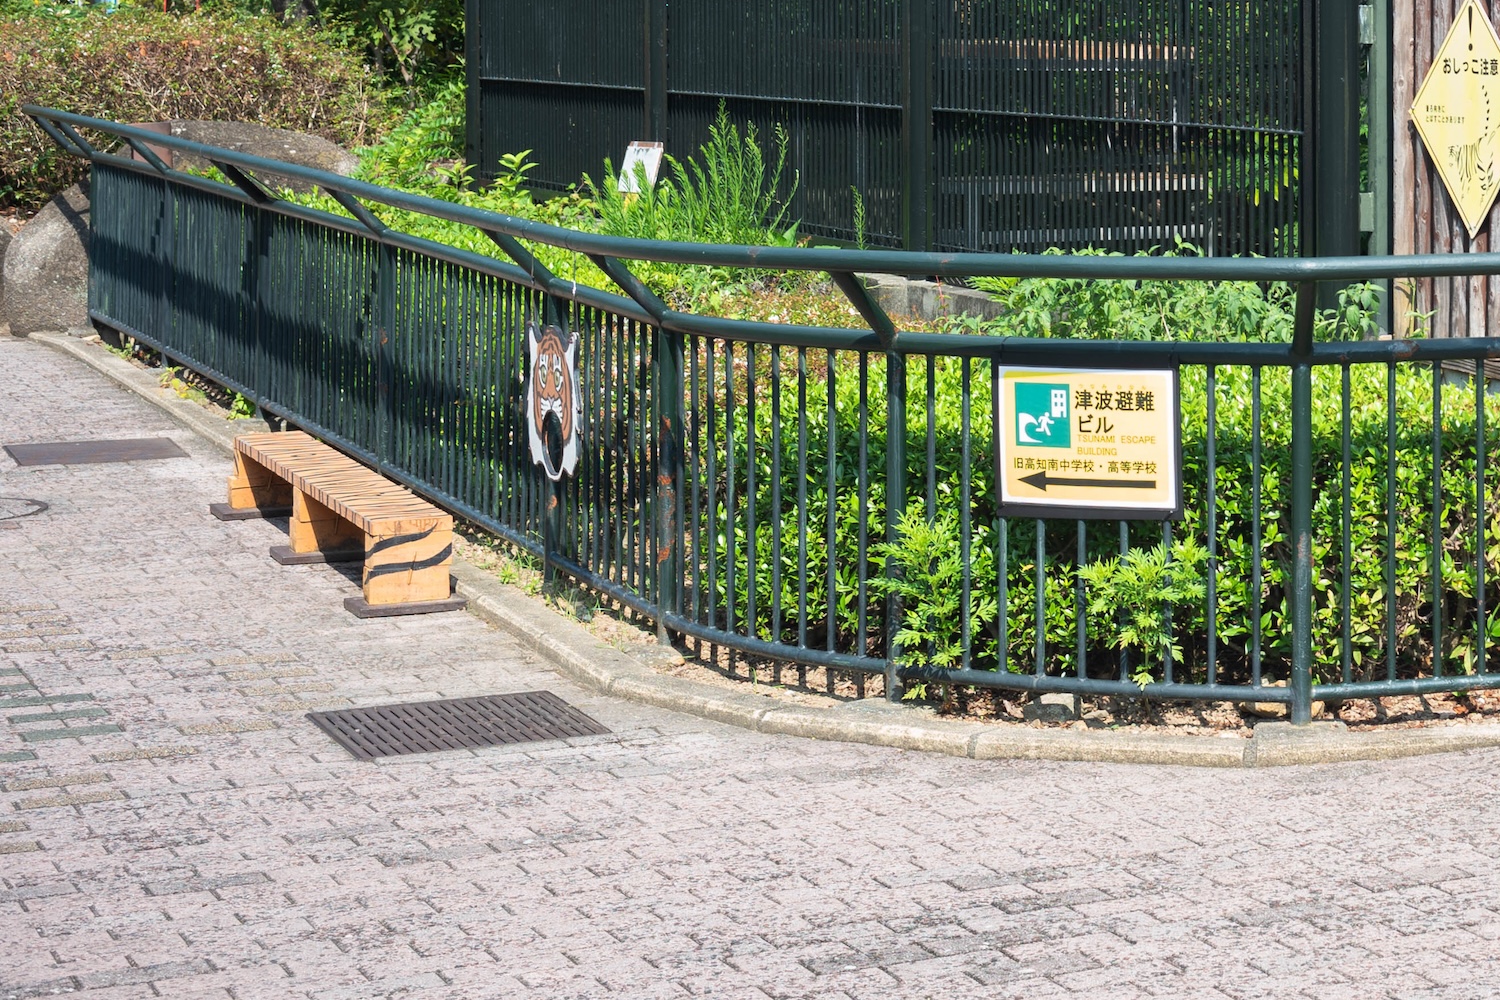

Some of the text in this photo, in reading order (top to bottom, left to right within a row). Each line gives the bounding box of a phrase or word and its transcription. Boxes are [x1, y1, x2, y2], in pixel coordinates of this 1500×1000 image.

[1443, 58, 1498, 75] おしっこ注意
[1075, 390, 1154, 411] 津波避難
[1078, 414, 1114, 433] ビル
[1077, 434, 1156, 444] TSUNAMI ESCAPE
[1077, 447, 1117, 455] BUILDING
[1014, 457, 1157, 474] 旧高知南中学校・高等学校
